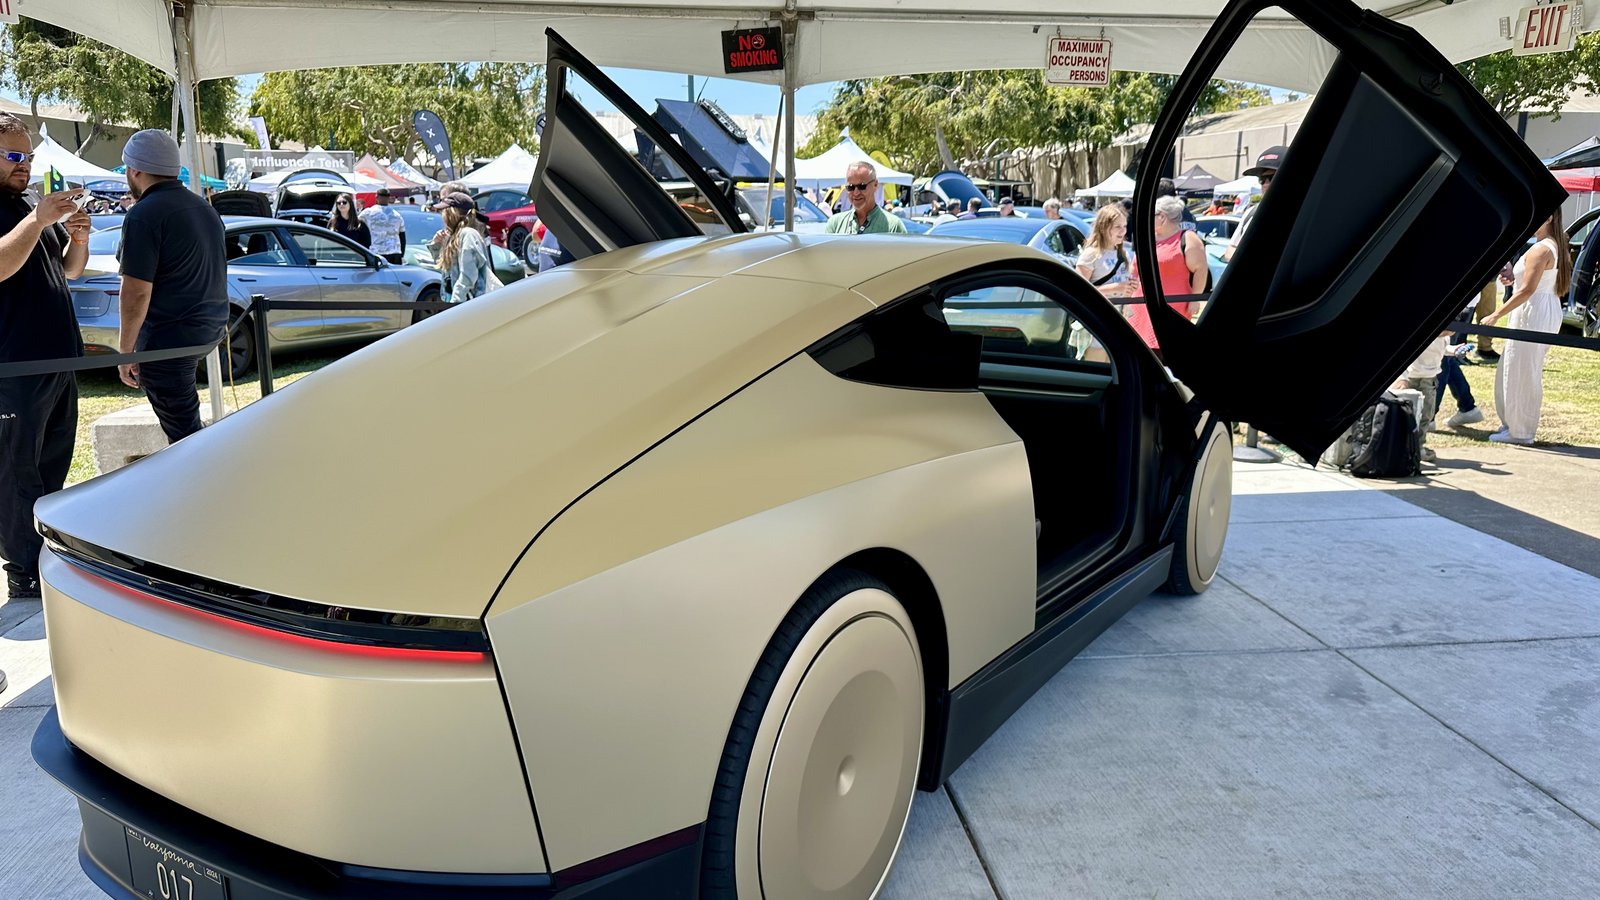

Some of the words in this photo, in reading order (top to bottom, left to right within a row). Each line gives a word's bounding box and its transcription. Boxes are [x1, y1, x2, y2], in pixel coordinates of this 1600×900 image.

[1523, 5, 1568, 49] EXIT
[738, 33, 765, 51] NO
[1057, 41, 1103, 53] MAXIMUM
[730, 49, 778, 68] SMOKING
[1051, 55, 1108, 68] OCCUPANCY
[1069, 70, 1106, 82] PERSONS
[253, 156, 315, 168] Influencer
[317, 157, 345, 168] Tent
[142, 836, 202, 875] California
[156, 862, 193, 900] 017
